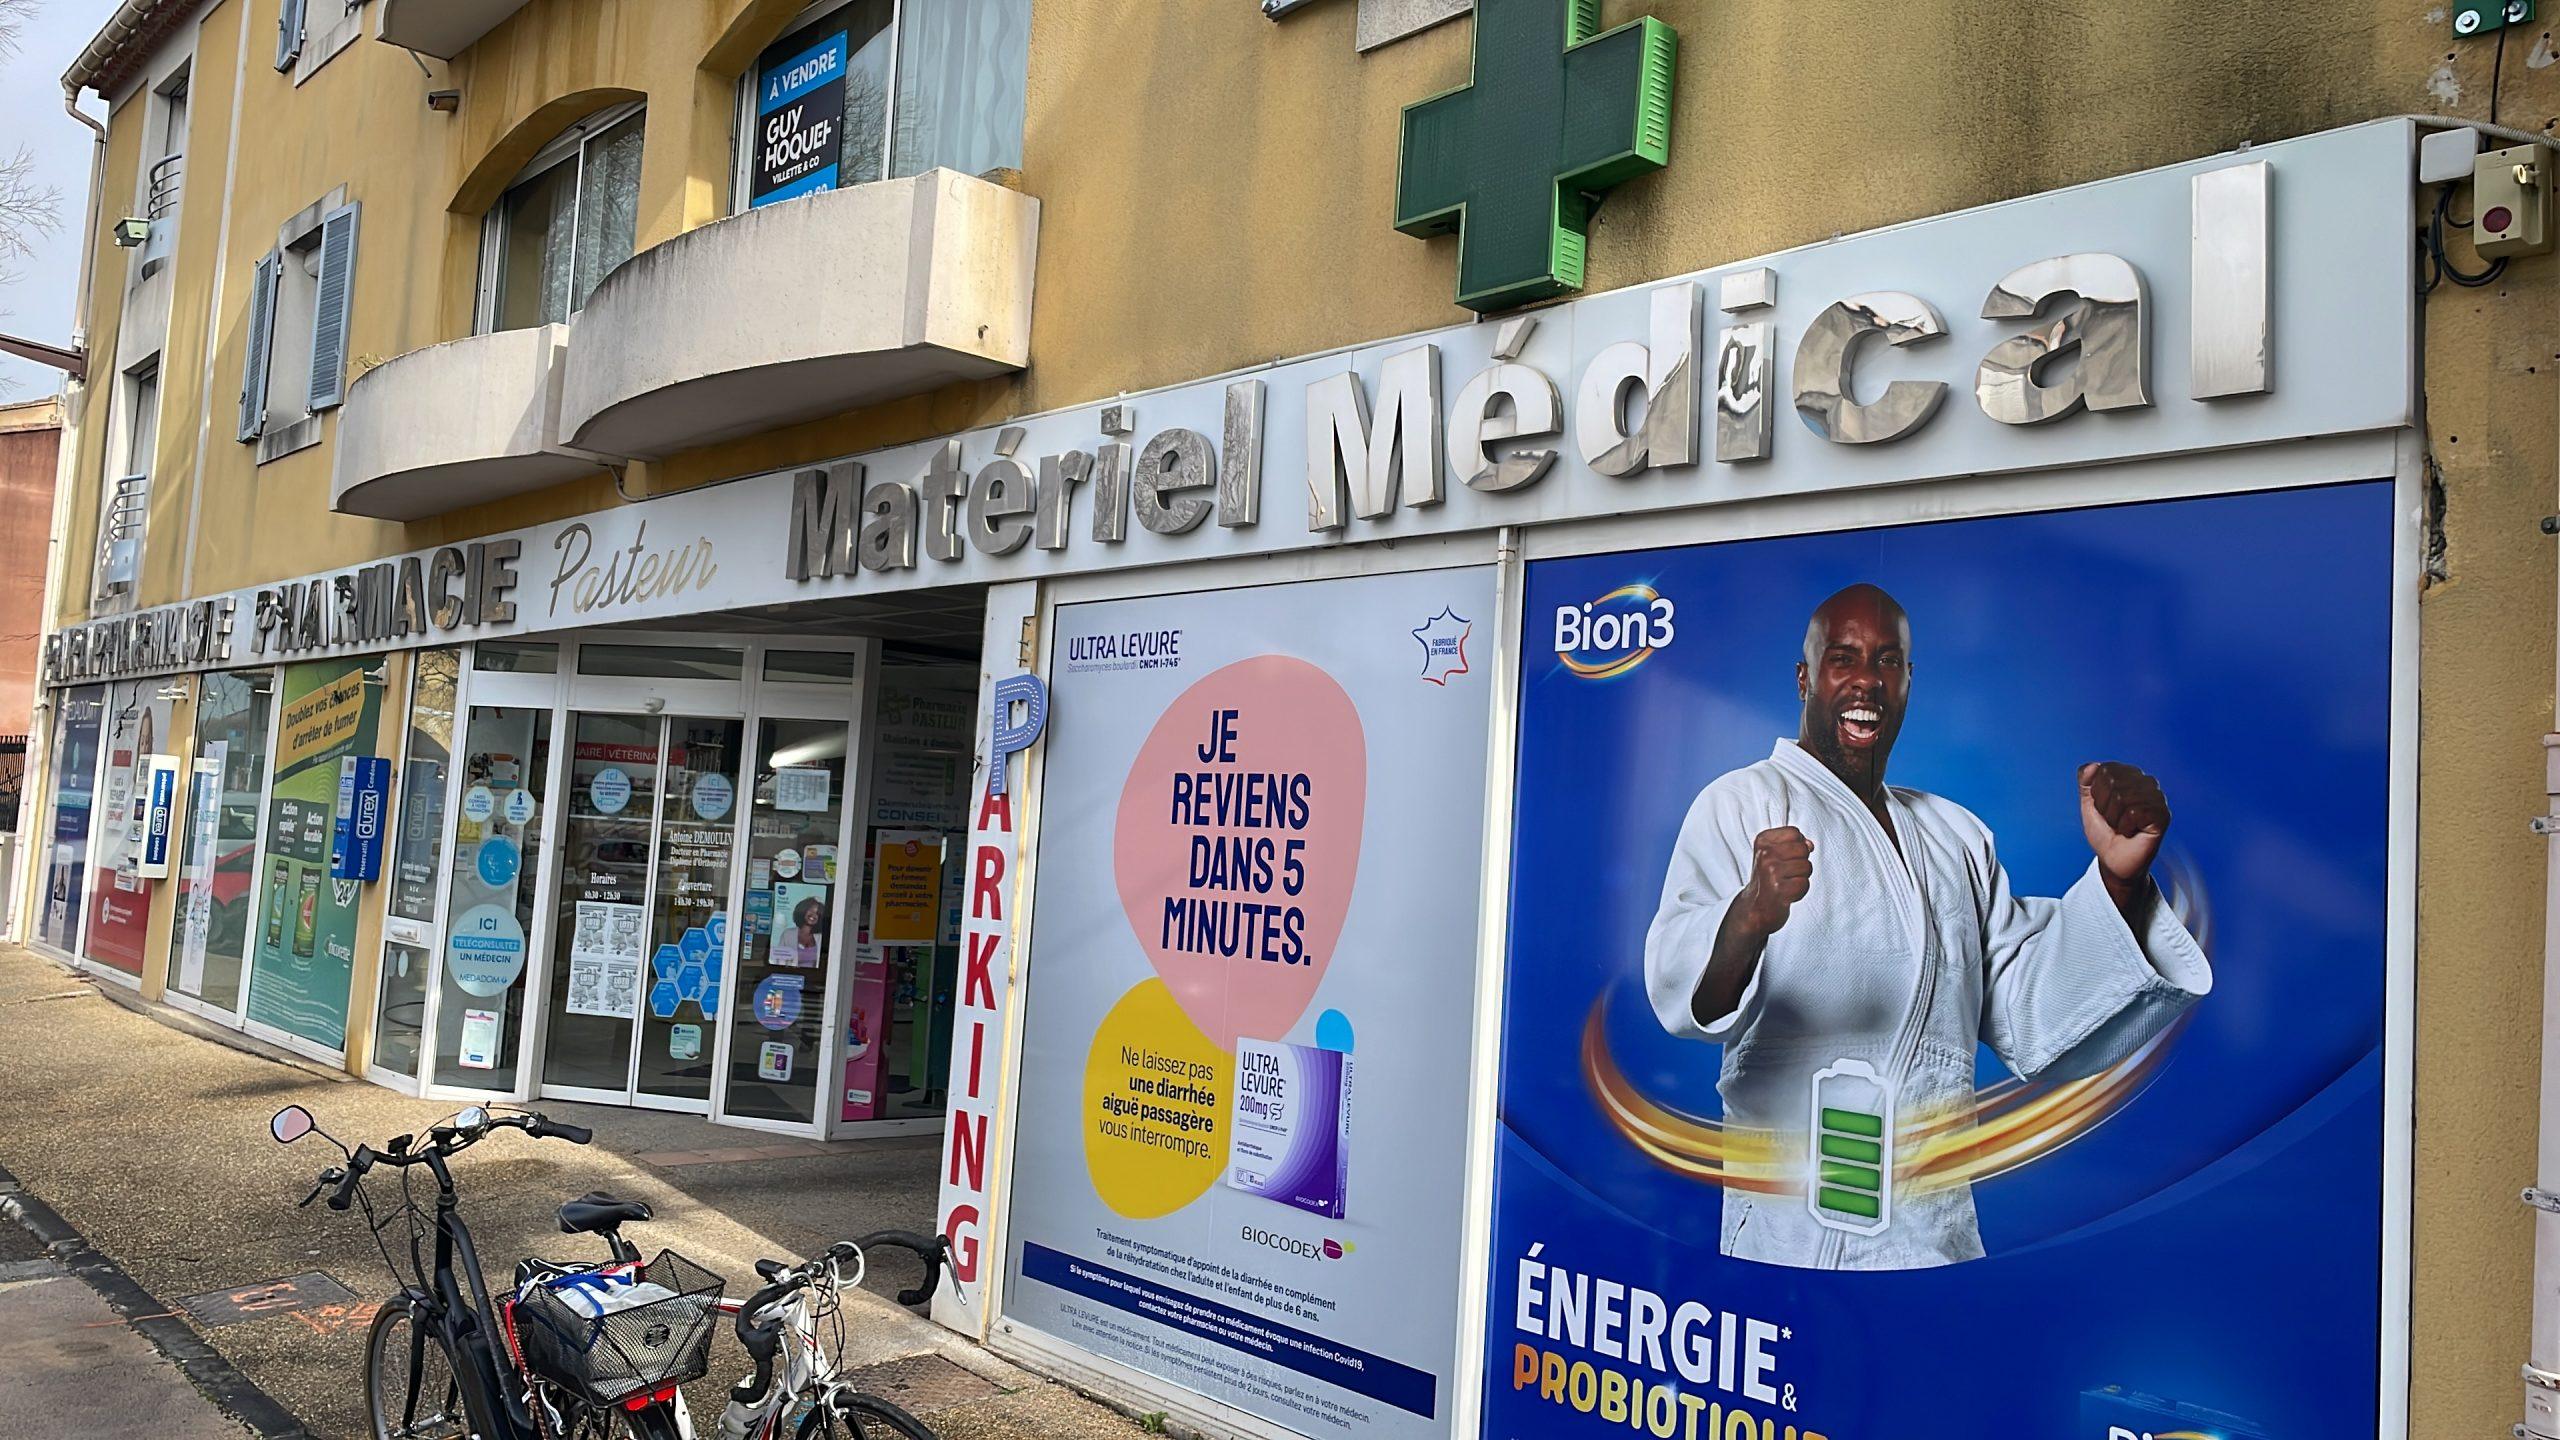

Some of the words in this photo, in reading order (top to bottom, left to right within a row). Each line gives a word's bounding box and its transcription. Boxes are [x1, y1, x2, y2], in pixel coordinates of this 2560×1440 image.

[782, 48, 837, 93] VENDRE
[767, 105, 803, 144] GUY
[772, 163, 802, 185] VILLETTE
[803, 161, 809, 172] &
[810, 155, 820, 169] CO
[786, 379, 1266, 580] Matériel
[1306, 158, 2274, 533] Médical
[250, 539, 522, 653] PHARMACIE
[550, 519, 717, 618] Pasteur
[1432, 635, 1457, 647] FABRIQUÉ
[1554, 598, 1675, 652] Bion3
[1069, 635, 1117, 661] ULTRA
[1139, 659, 1159, 669] CNCM
[1431, 648, 1438, 656] EN
[1439, 647, 1458, 655] FRANCE
[286, 704, 314, 730] Doublez
[315, 697, 328, 714] vos
[323, 720, 332, 737] de
[333, 710, 358, 732] fumer
[1198, 709, 1239, 764] JE
[306, 811, 324, 826] Action
[359, 793, 377, 837] durex
[1171, 773, 1311, 830] REVIENS
[154, 808, 167, 834] durex
[669, 830, 693, 843] Antoine
[670, 847, 692, 856] Docteur
[693, 849, 699, 857] en
[700, 848, 728, 858] Pharmacie
[1189, 835, 1275, 894] DANS
[1283, 839, 1306, 897] 5
[584, 890, 599, 900] 8h30
[590, 872, 617, 885] Horaires
[479, 917, 497, 931] ICI
[1162, 897, 1311, 966] MINUTES.
[459, 952, 472, 962] UN
[474, 951, 511, 963] MÉDECIN
[1121, 1045, 1139, 1066] Ne
[1142, 1048, 1187, 1076] laissez
[1188, 1062, 1214, 1081] pas
[1243, 1051, 1280, 1076] ULTRA
[1129, 1076, 1154, 1094] une
[1156, 1077, 1216, 1107] diarrhée
[1240, 1094, 1268, 1120] 200mg
[1102, 1092, 1139, 1116] aiguë
[1140, 1103, 1214, 1133] passagère
[1099, 1119, 1128, 1139] vous
[1130, 1121, 1211, 1160] interrompre.
[1242, 1226, 1321, 1261] BIOCODEX
[1096, 1228, 1132, 1248] Traitement
[1132, 1241, 1186, 1264] symptomatique
[1187, 1255, 1220, 1275] d'appoint
[1221, 1266, 1231, 1277] de
[1232, 1268, 1239, 1280] la
[1240, 1272, 1273, 1290] diarrhée
[1274, 1284, 1284, 1294] en
[1285, 1287, 1336, 1311] complément
[1106, 1246, 1115, 1257] de
[1116, 1248, 1123, 1259] la
[1123, 1251, 1169, 1274] réhydratation
[1170, 1266, 1187, 1280] chez
[1188, 1271, 1215, 1288] l'adulte
[1215, 1282, 1223, 1292] et
[1224, 1282, 1253, 1301] l'enfant
[1254, 1292, 1264, 1304] de
[1265, 1296, 1283, 1310] plus
[1283, 1302, 1294, 1313] de
[1295, 1305, 1301, 1316] 6
[1302, 1309, 1320, 1322] ans.
[1069, 1264, 1076, 1273] Si
[1076, 1265, 1081, 1275] le
[1109, 1278, 1123, 1289] pour
[1123, 1281, 1141, 1295] lequel
[1142, 1290, 1155, 1300] vous
[1184, 1301, 1192, 1312] de
[1193, 1306, 1217, 1319] prendre
[1217, 1315, 1225, 1324] ce
[1225, 1316, 1265, 1337] médicament
[1265, 1328, 1289, 1345] évoque
[1289, 1339, 1303, 1350] une
[1303, 1341, 1334, 1361] infection
[1334, 1352, 1365, 1371] Covid19,
[1138, 1300, 1167, 1316] contactez
[1167, 1309, 1182, 1321] votre
[1183, 1315, 1218, 1332] pharmacien
[1218, 1327, 1226, 1336] ou
[1227, 1329, 1243, 1342] votre
[1244, 1334, 1274, 1352] médecin.
[1060, 1303, 1078, 1315] ULTRA
[1152, 1336, 1165, 1348] Tout
[1201, 1353, 1215, 1367] peut
[1216, 1360, 1240, 1377] exposer
[1240, 1367, 1245, 1377] à
[1245, 1370, 1258, 1382] des
[1258, 1375, 1283, 1393] risques,
[1284, 1384, 1304, 1400] parlez
[1305, 1393, 1314, 1402] en
[1314, 1394, 1320, 1404] à
[1320, 1399, 1339, 1412] votre
[1339, 1404, 1371, 1424] médecin.
[1238, 1379, 1247, 1390] de
[1247, 1382, 1252, 1392] 2
[1252, 1385, 1270, 1400] jours,
[1270, 1392, 1302, 1411] consultez
[1302, 1405, 1320, 1418] votre
[1321, 1411, 1352, 1431] médecin.
[1513, 1343, 1829, 1440] PROBIOTIQ
[1782, 1383, 1797, 1412] &
